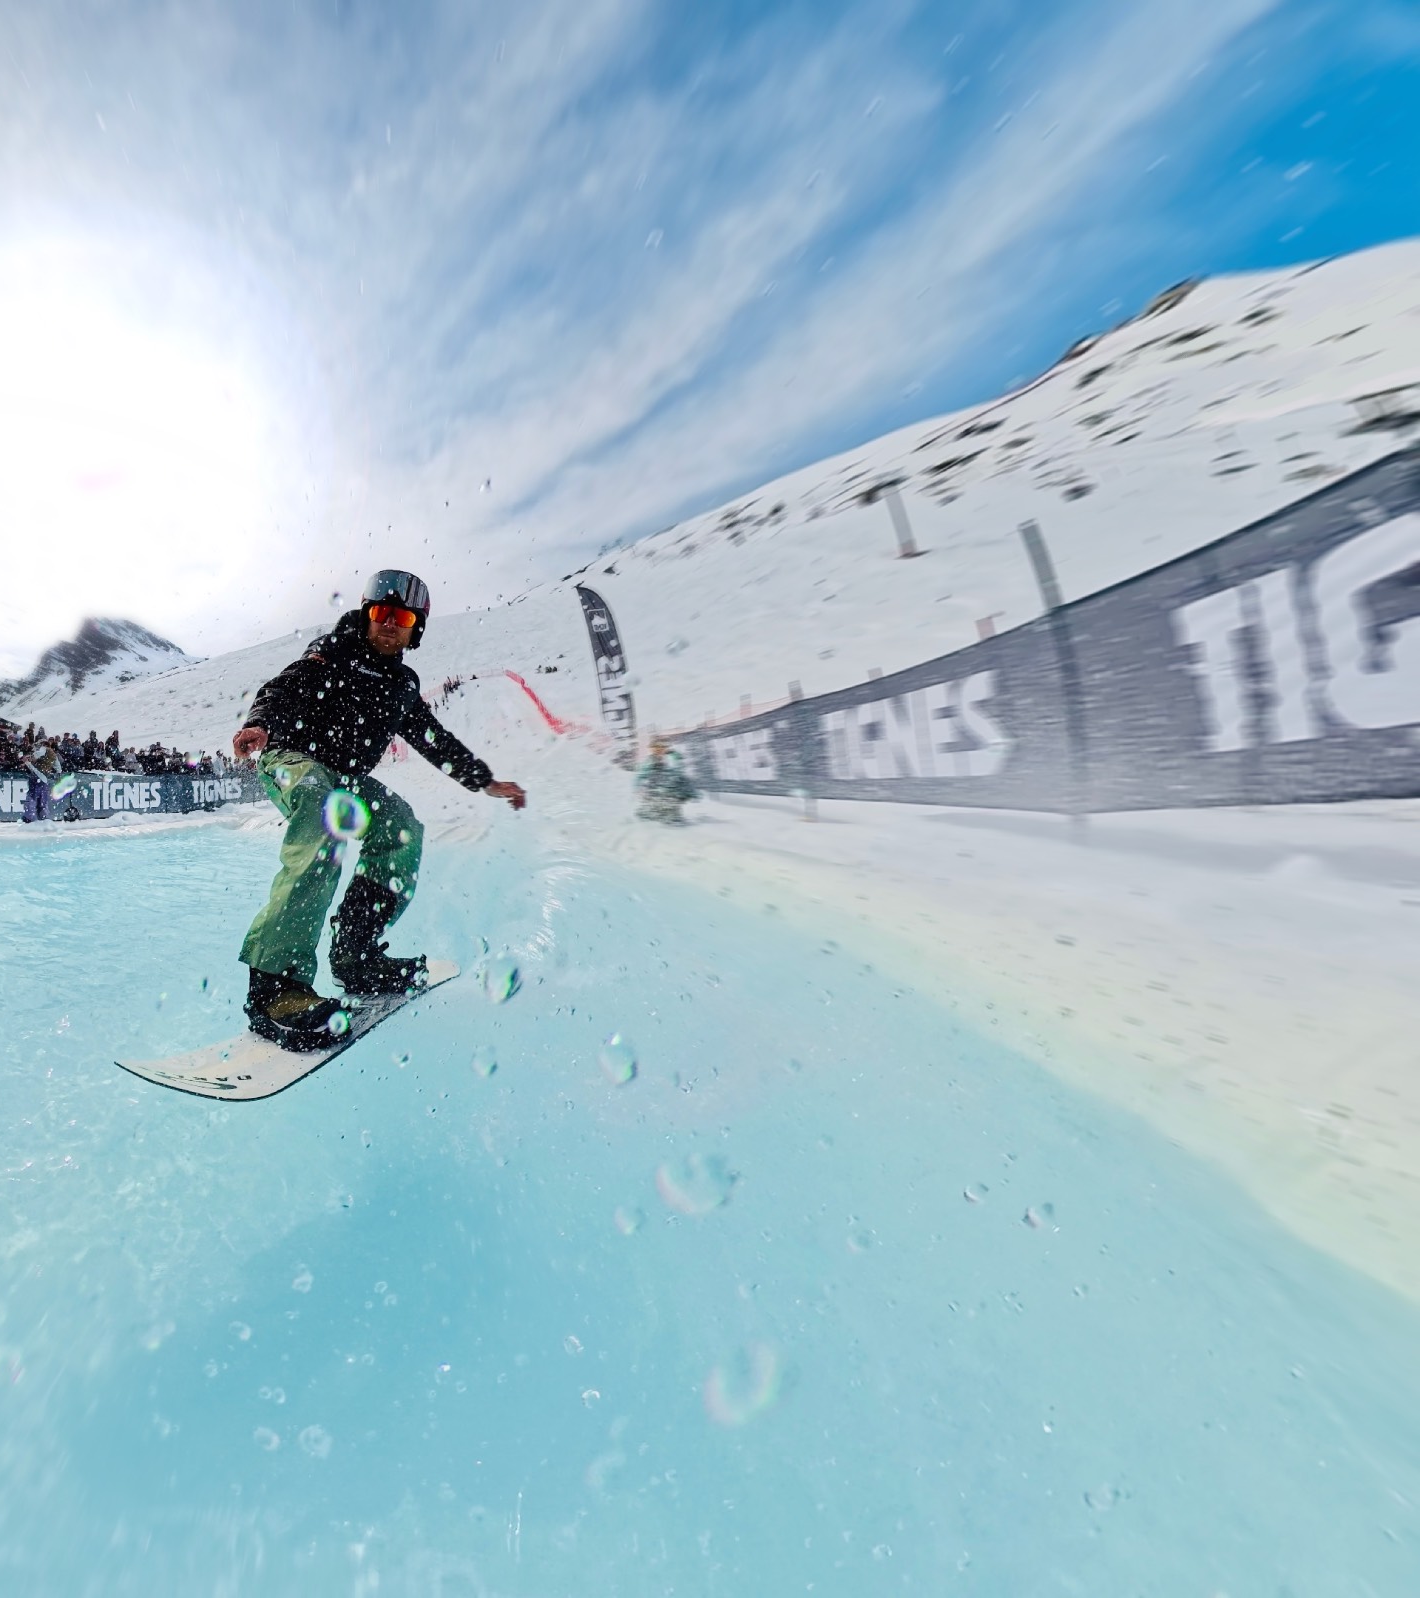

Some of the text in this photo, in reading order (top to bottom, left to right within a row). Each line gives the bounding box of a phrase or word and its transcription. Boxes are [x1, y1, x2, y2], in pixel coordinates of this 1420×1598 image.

[1171, 511, 1420, 752] TIG
[90, 781, 162, 810] TIGNES
[191, 777, 242, 803] TIGNES
